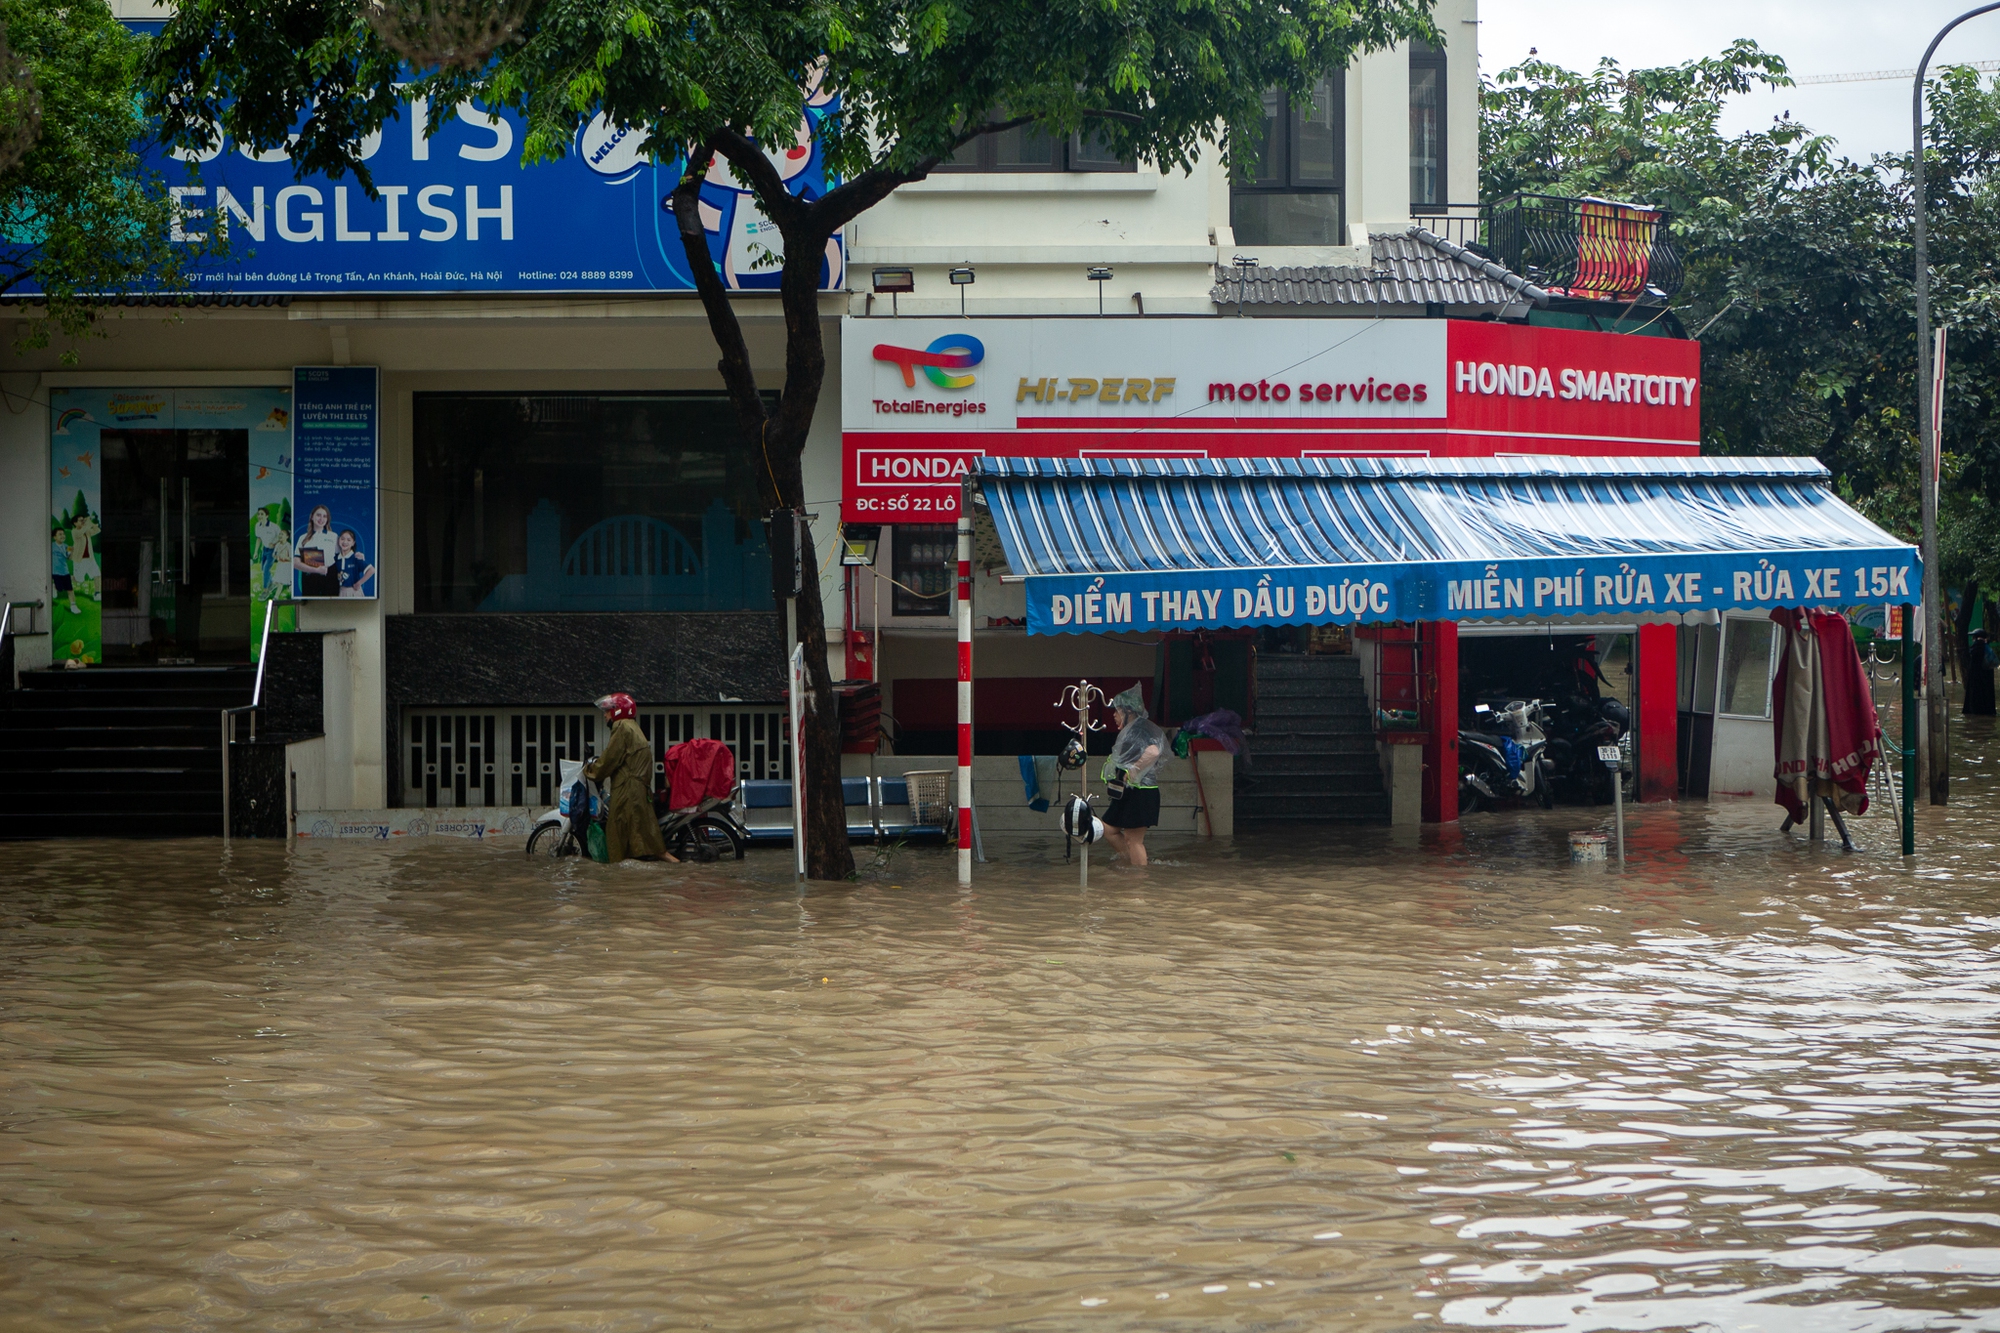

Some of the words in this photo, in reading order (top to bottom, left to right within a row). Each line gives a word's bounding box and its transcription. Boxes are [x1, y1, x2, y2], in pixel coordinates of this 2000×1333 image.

[169, 183, 514, 242] ENGLISH
[206, 272, 224, 281] mới
[227, 272, 241, 281] hai
[245, 272, 263, 281] bên
[267, 272, 297, 283] đường
[300, 273, 312, 281] Lê
[315, 272, 342, 283] Trọng
[345, 272, 365, 282] Tấn,
[368, 272, 380, 281] An
[384, 272, 417, 281] Khánh,
[421, 272, 442, 280] Hoài
[445, 272, 467, 281] Đức,
[471, 272, 483, 280] Hà
[487, 272, 502, 281] Nội
[519, 271, 557, 280] Hotline:
[560, 271, 578, 280] 024
[581, 271, 606, 280] 8889
[609, 271, 633, 280] 8399
[1209, 379, 1291, 402] moto
[1299, 377, 1428, 402] services
[1456, 361, 1555, 399] HONDA
[1560, 368, 1697, 407] SMARTCITY
[298, 401, 323, 410] TIẾNG
[345, 401, 358, 410] TRẺ
[872, 399, 986, 417] TotalEnergies
[302, 412, 328, 421] LUYỆN
[872, 457, 970, 478] HONDA
[913, 498, 931, 511] 22
[936, 494, 956, 511] LÔ
[1051, 577, 1132, 625] ĐIỂM
[1141, 588, 1222, 622] THAY
[1233, 574, 1295, 619] DẦU
[1305, 578, 1389, 620] ĐƯỢC
[1447, 564, 1524, 611] MIỄN
[1533, 568, 1585, 607] PHÍ
[1594, 562, 1656, 606] RỬA
[1663, 572, 1702, 604] XE
[1733, 558, 1795, 601] RỬA
[1804, 568, 1841, 599] XE
[1854, 565, 1910, 598] 15K
[339, 825, 390, 840] ALCOREST
[435, 824, 486, 840] ALCOREST
